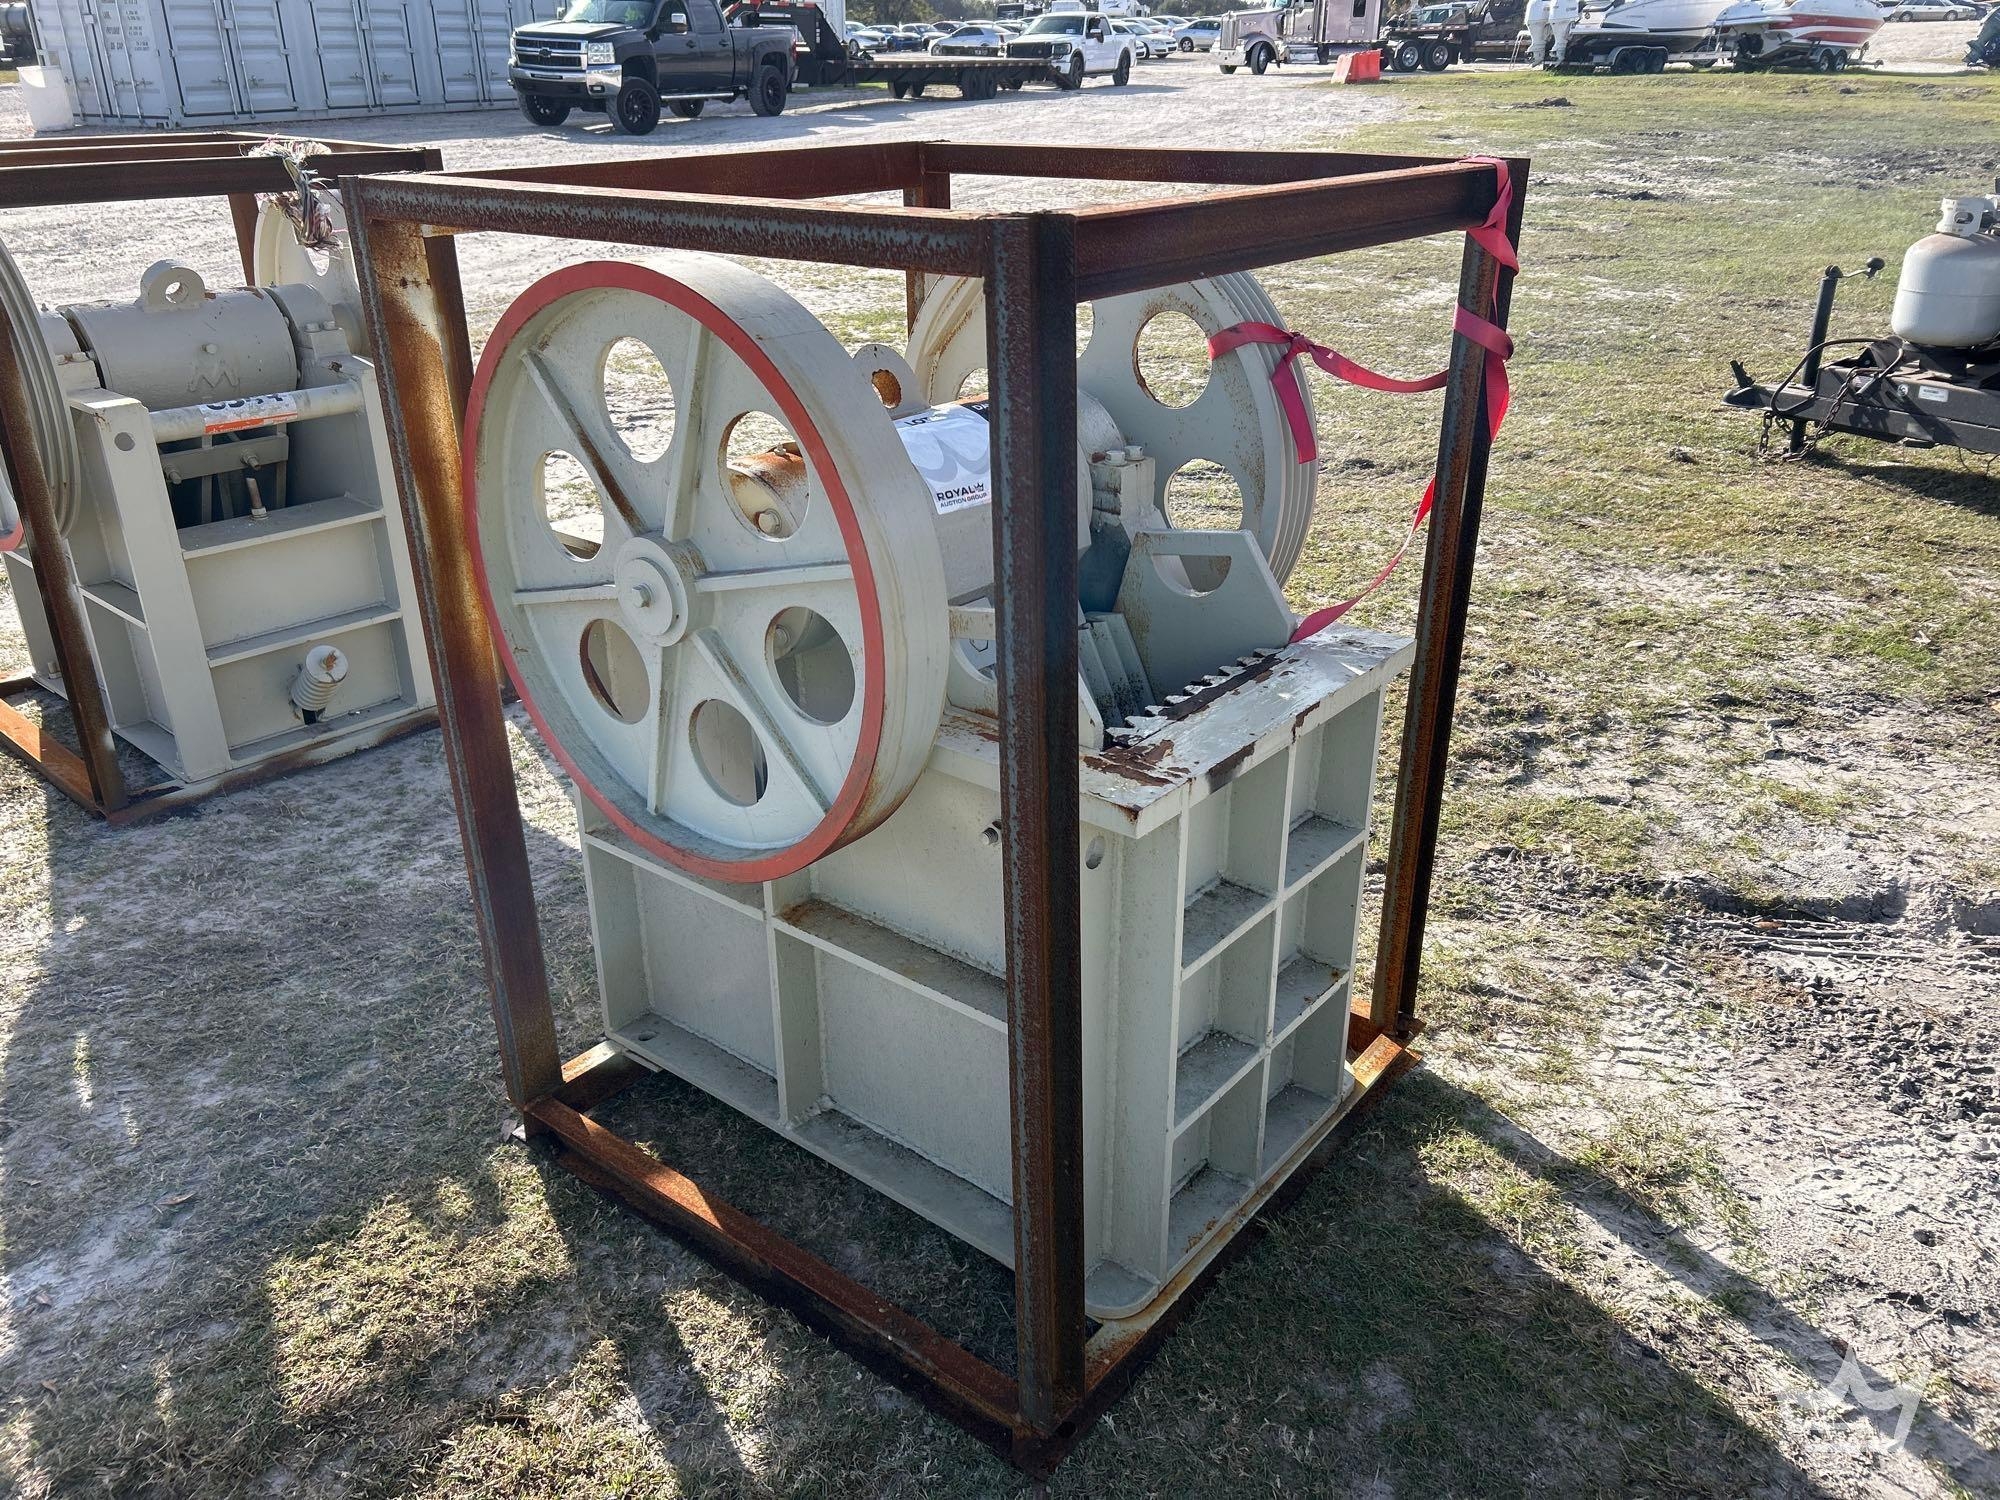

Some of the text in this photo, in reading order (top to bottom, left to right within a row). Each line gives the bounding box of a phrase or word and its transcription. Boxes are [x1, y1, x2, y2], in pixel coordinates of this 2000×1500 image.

[936, 485, 976, 501] ROYAL
[940, 492, 988, 508] AUCTION GROUP
